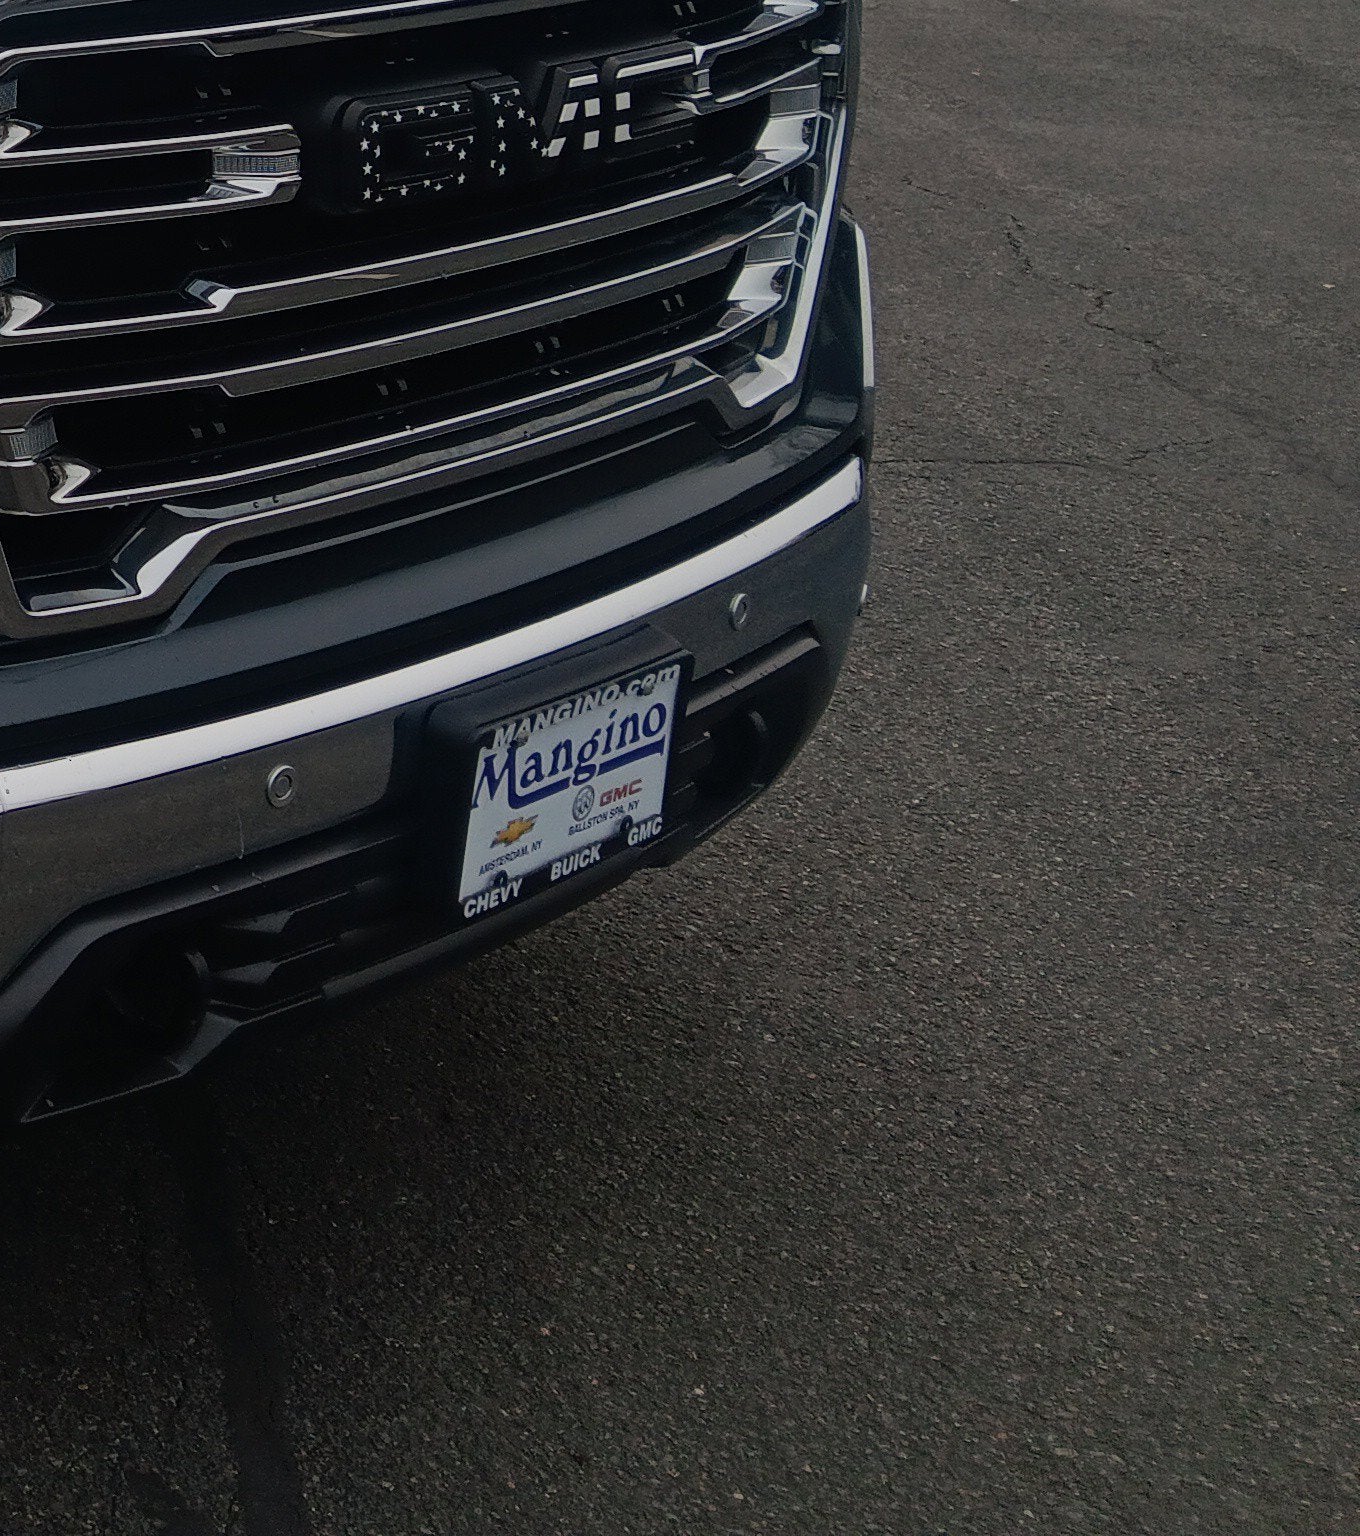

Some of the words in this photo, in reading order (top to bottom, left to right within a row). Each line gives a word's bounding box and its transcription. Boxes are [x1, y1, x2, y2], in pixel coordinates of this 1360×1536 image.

[352, 49, 696, 210] GMC
[472, 702, 668, 810] Mangino
[492, 664, 680, 751] MANGINO.com
[600, 779, 642, 807] GMC
[463, 878, 523, 919] CHEVY
[550, 843, 602, 882] BUICK
[627, 816, 663, 847] GMC
